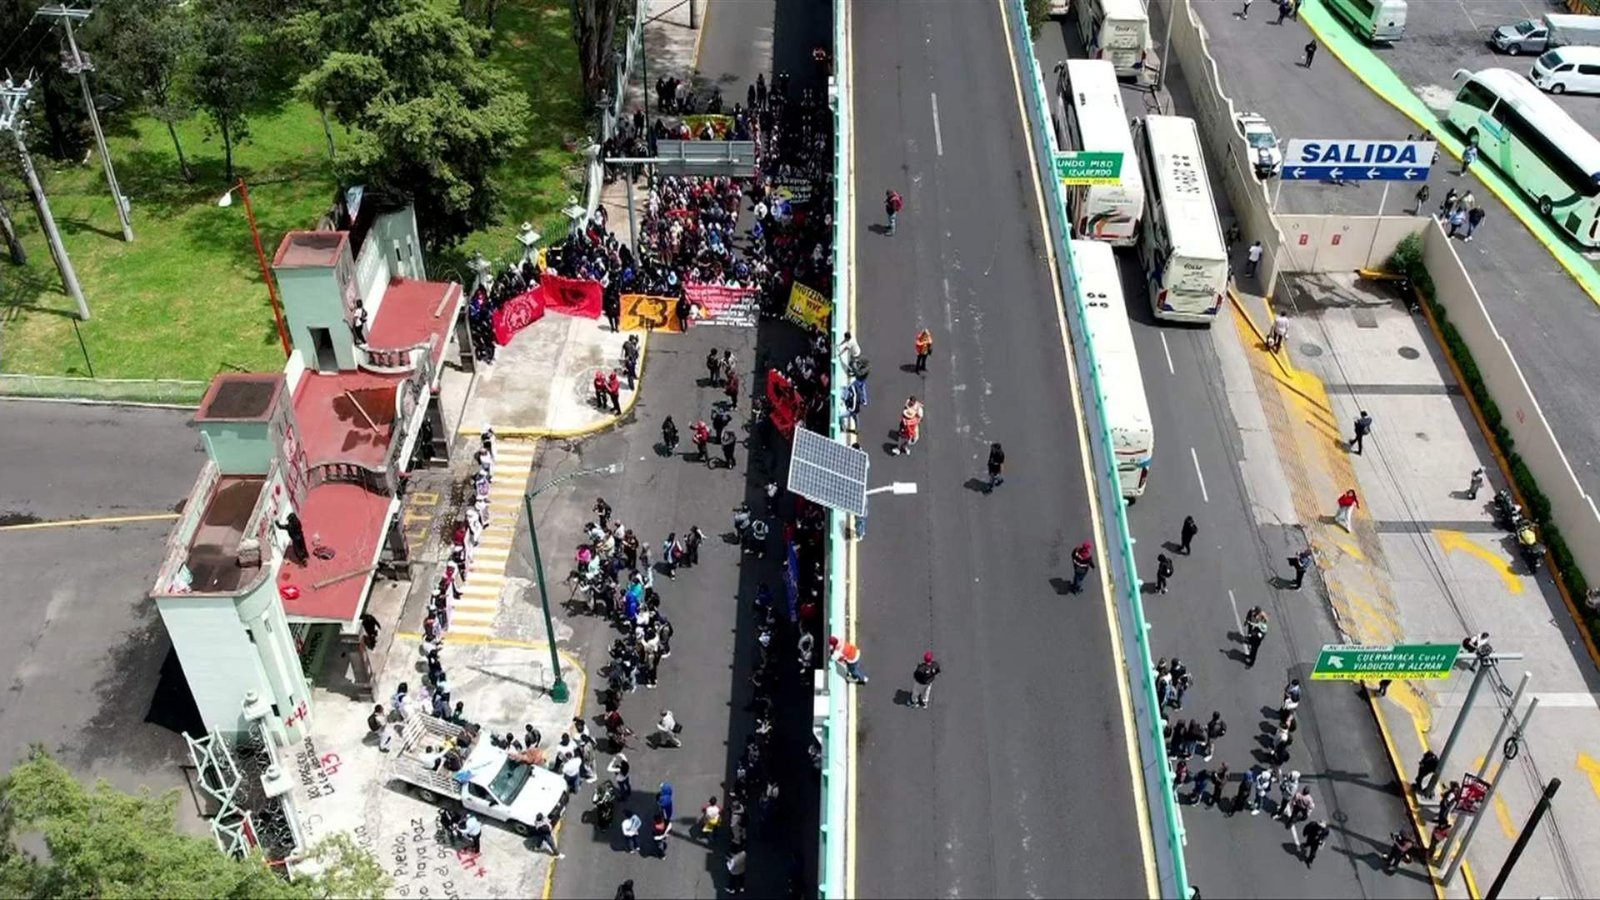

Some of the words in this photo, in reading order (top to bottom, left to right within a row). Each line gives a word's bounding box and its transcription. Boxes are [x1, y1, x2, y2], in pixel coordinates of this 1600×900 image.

[1301, 143, 1417, 164] SALIDA
[1057, 160, 1085, 168] UNDO
[1090, 160, 1114, 168] PISO
[1356, 653, 1414, 662] CUERNAVACA
[1418, 653, 1447, 662] Cuota
[1353, 662, 1394, 670] VIADUCTO
[410, 817, 430, 846] paz
